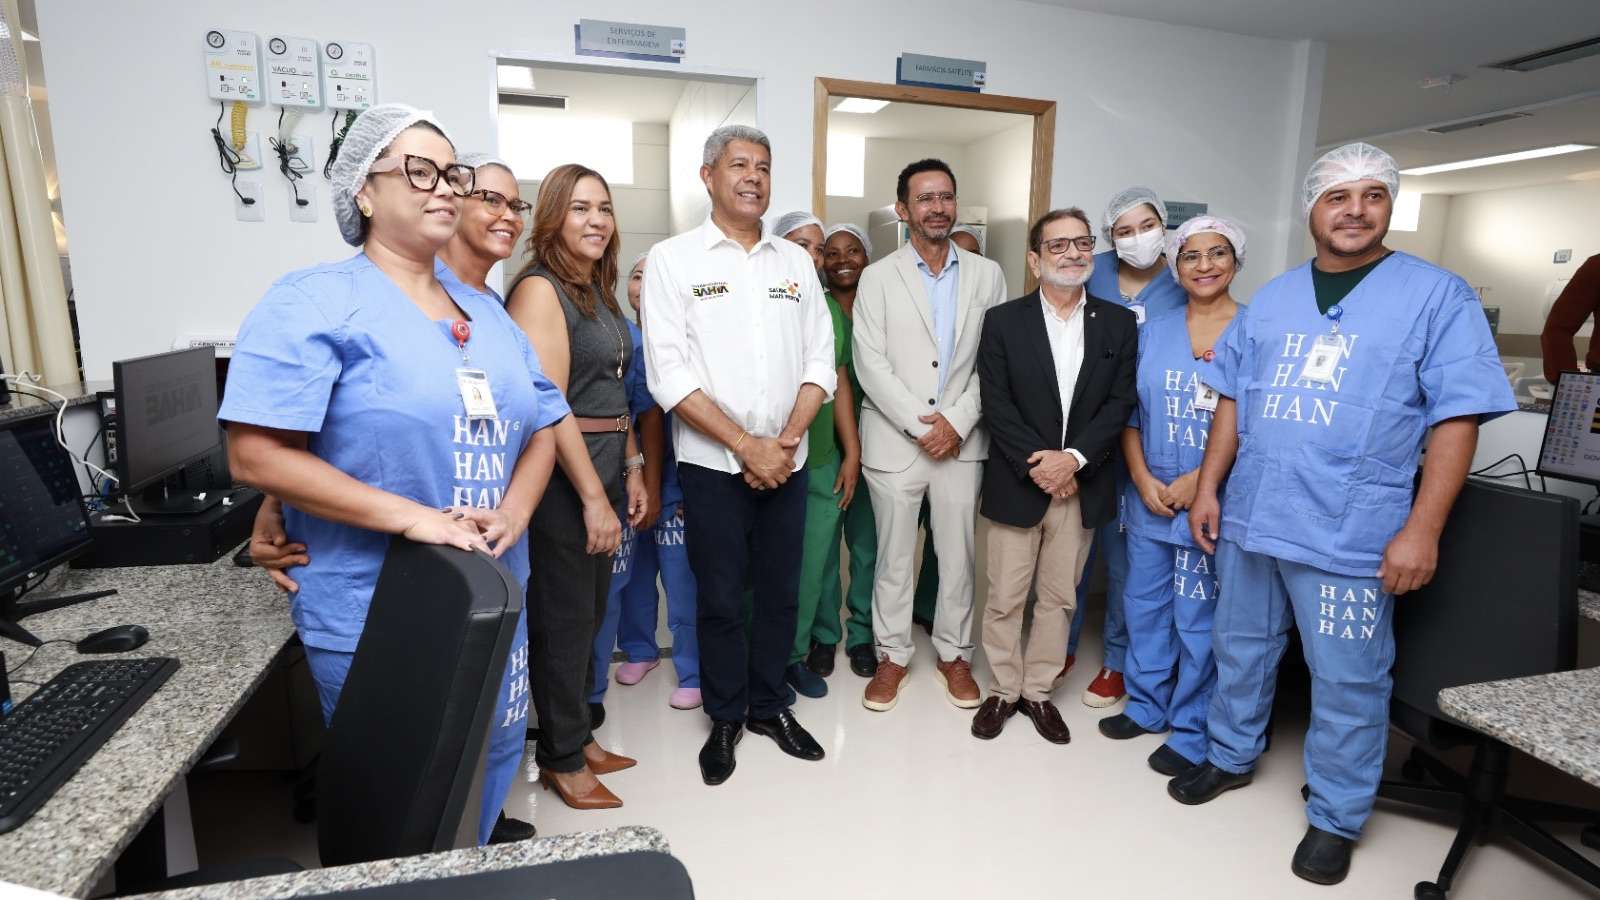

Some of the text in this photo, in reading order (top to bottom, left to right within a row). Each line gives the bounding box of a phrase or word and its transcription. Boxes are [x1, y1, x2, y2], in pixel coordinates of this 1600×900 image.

[1281, 333, 1359, 360] HN
[1164, 369, 1199, 393] HA
[1261, 394, 1339, 426] HAN
[453, 414, 511, 447] HAN
[453, 451, 506, 481] HAN
[615, 541, 633, 557] AN
[1175, 547, 1210, 575] HA
[1319, 583, 1377, 603] HAN
[1319, 601, 1377, 621] HAN
[1318, 619, 1375, 639] HAN
